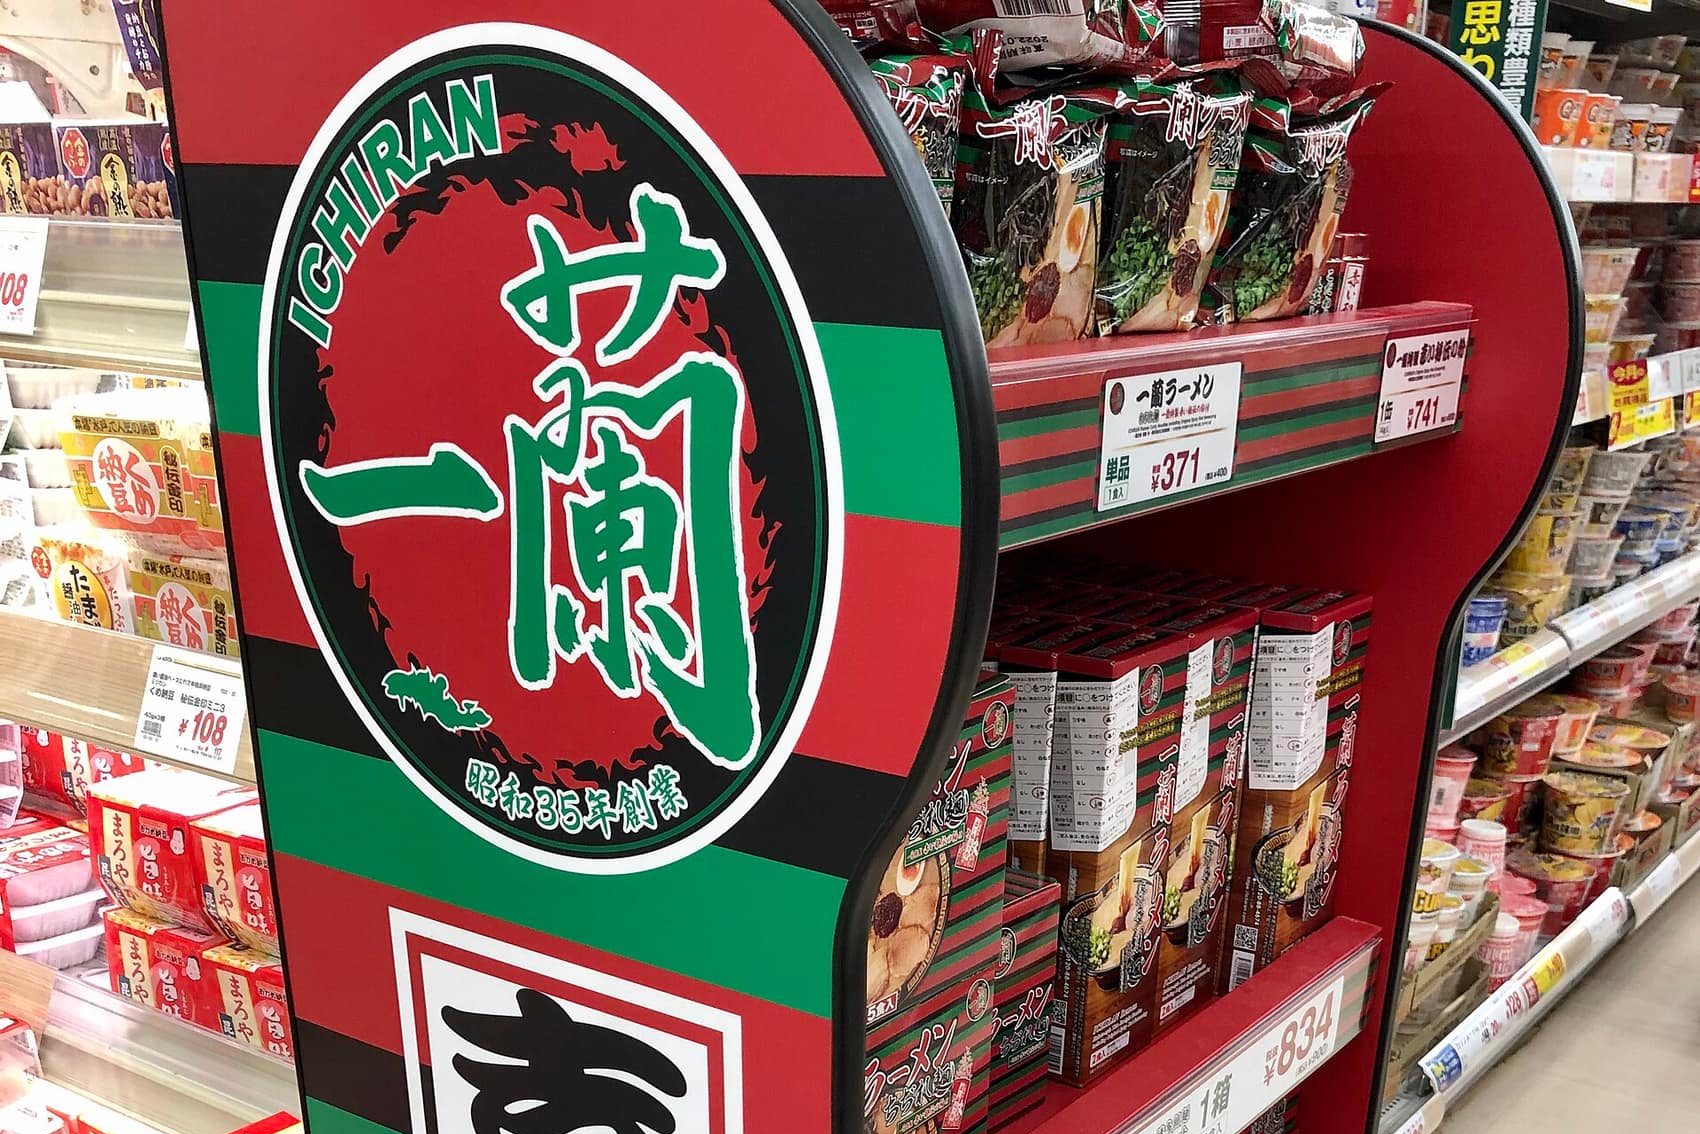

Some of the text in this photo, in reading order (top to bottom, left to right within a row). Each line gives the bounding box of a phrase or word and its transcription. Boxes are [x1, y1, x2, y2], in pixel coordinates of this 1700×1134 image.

[288, 74, 502, 349] ICHIRAN
[1136, 373, 1215, 409] 一蘭ラーメン
[163, 450, 184, 513] 秘伝金印
[300, 184, 762, 770] 一蘭
[1105, 455, 1130, 484] 単品
[70, 739, 88, 798] まろや
[465, 758, 688, 838] 昭和35年創業
[867, 998, 896, 1021] 5食入
[1200, 1073, 1233, 1129] 1箱
